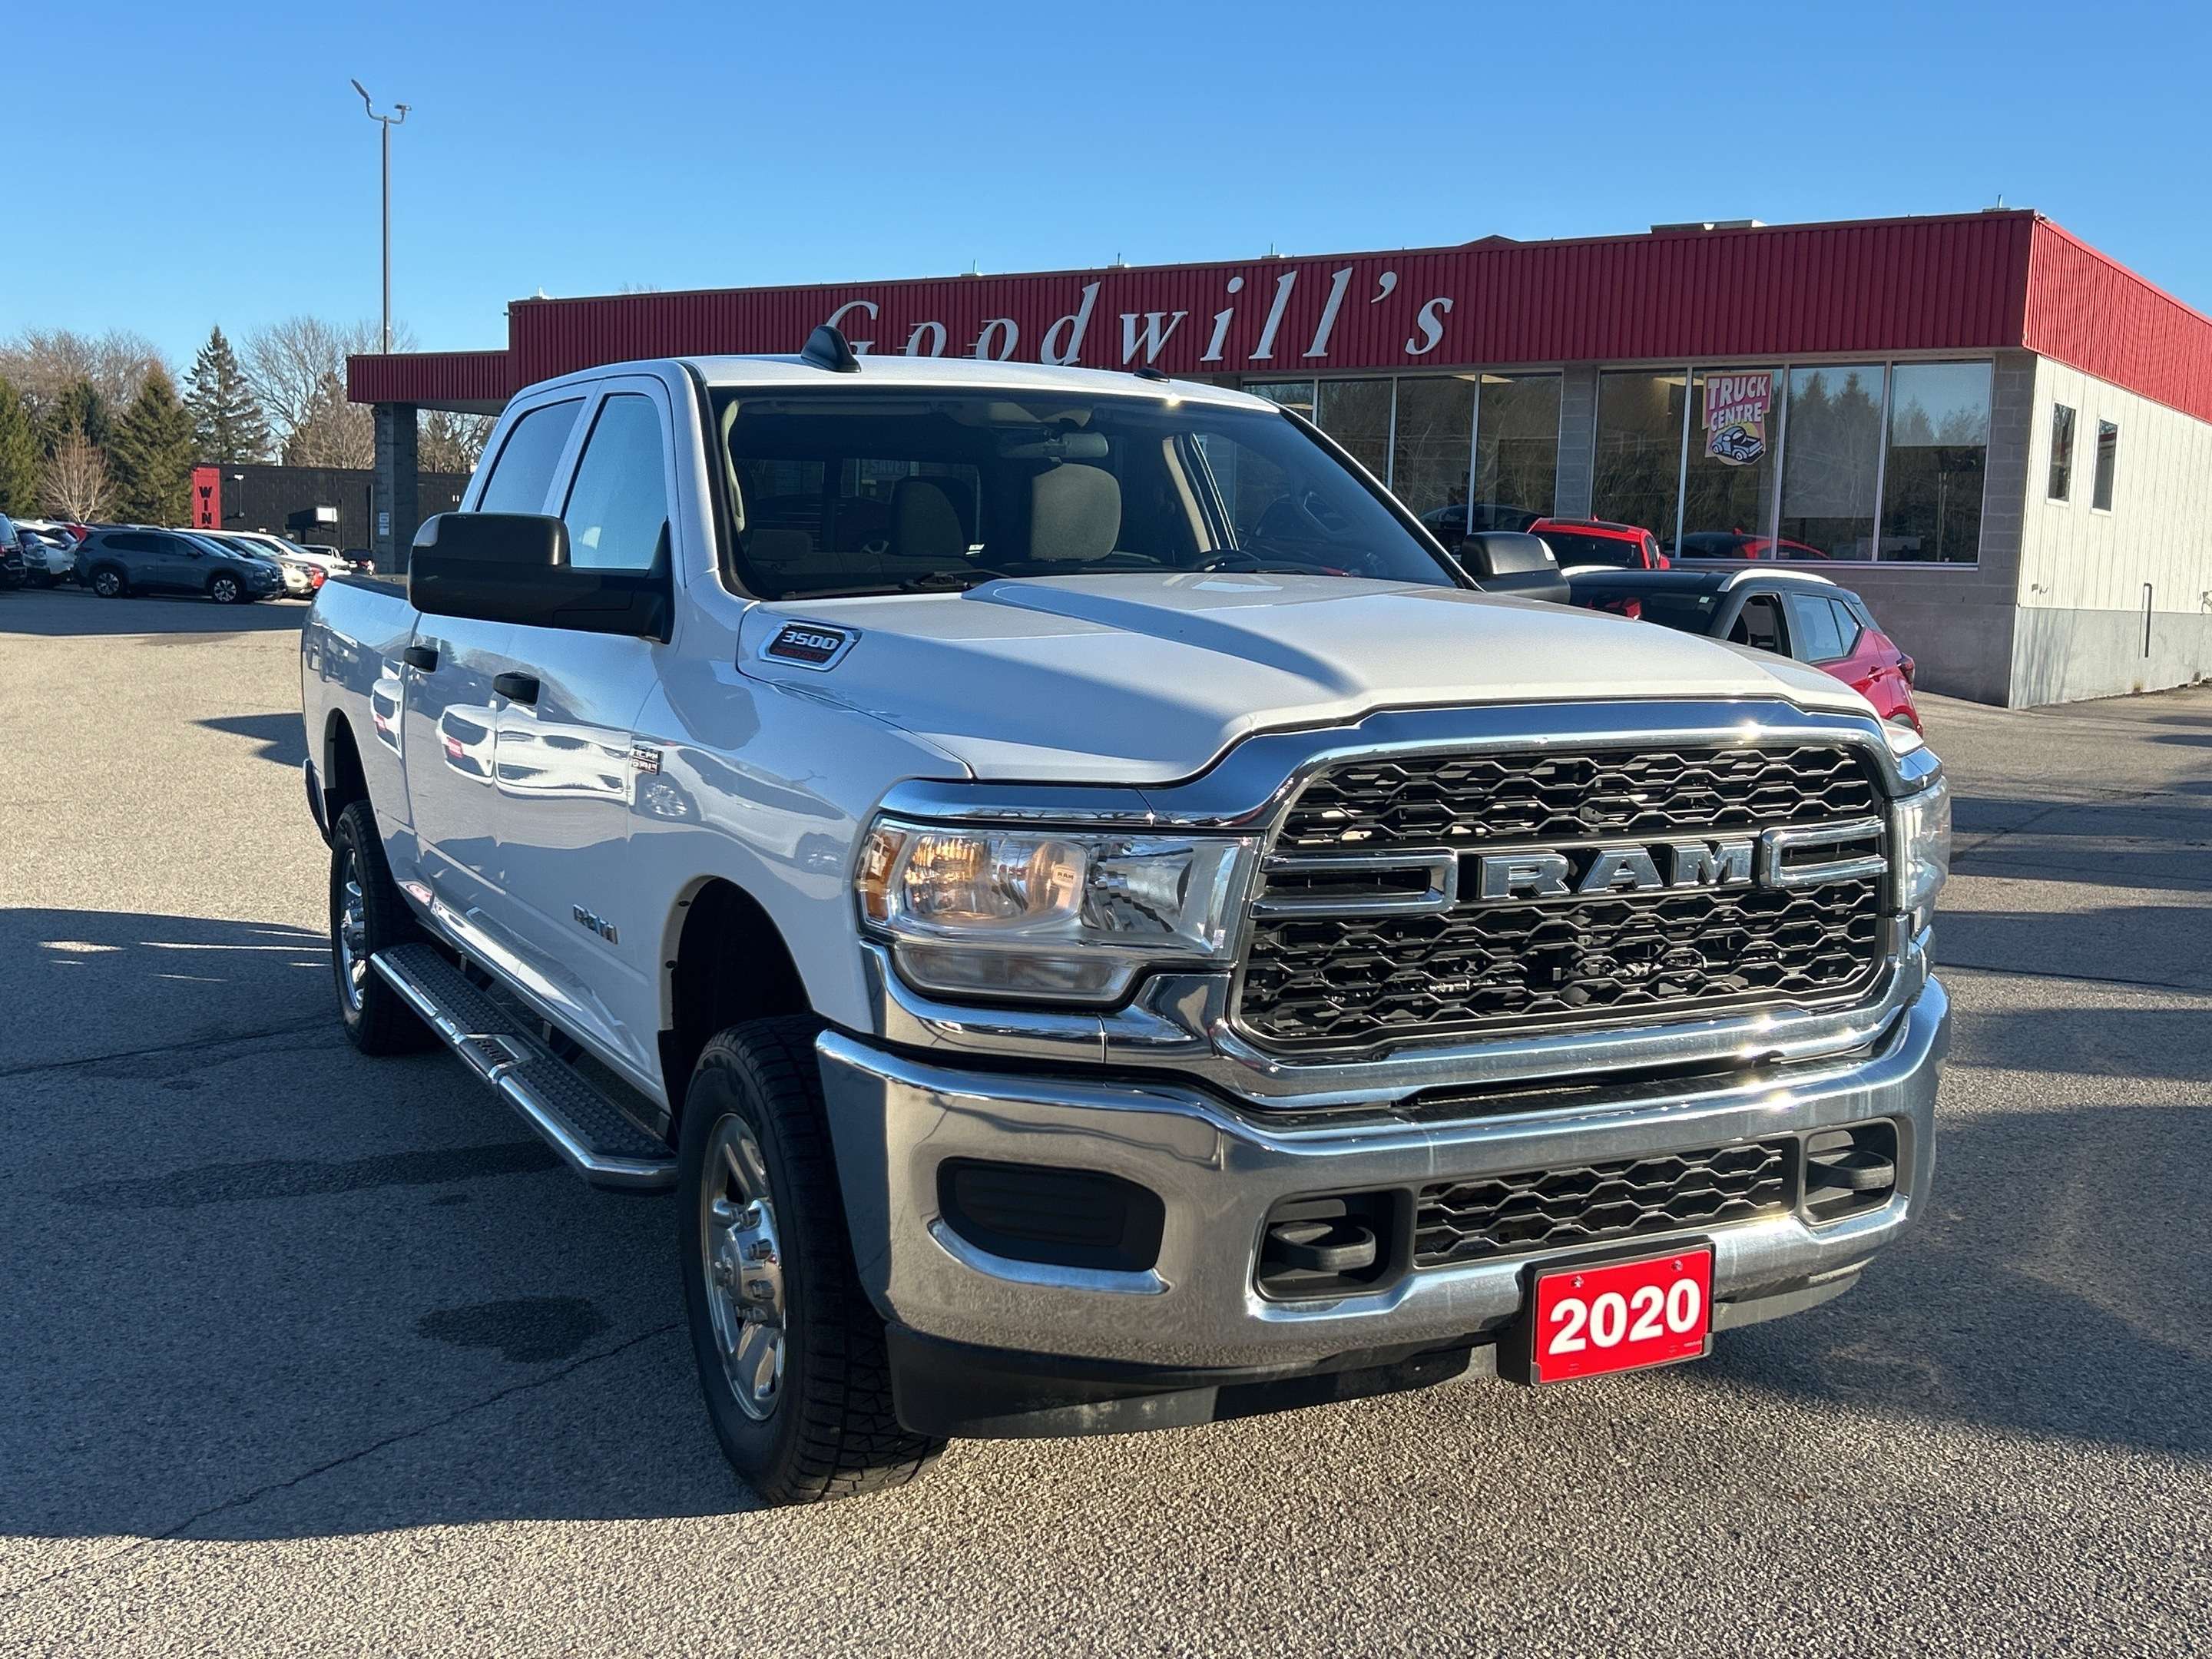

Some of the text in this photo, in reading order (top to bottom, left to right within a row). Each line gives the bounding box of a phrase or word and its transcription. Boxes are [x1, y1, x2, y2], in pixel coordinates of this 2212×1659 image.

[826, 267, 1454, 366] Goodwill's
[1707, 376, 1768, 410] TRUCK
[1710, 402, 1763, 432] CENTRE
[199, 486, 213, 528] WIN
[781, 631, 839, 650] 3500
[1057, 871, 1075, 880] RAM
[1478, 836, 1754, 899] RAM
[1548, 1278, 1701, 1355] 2020
